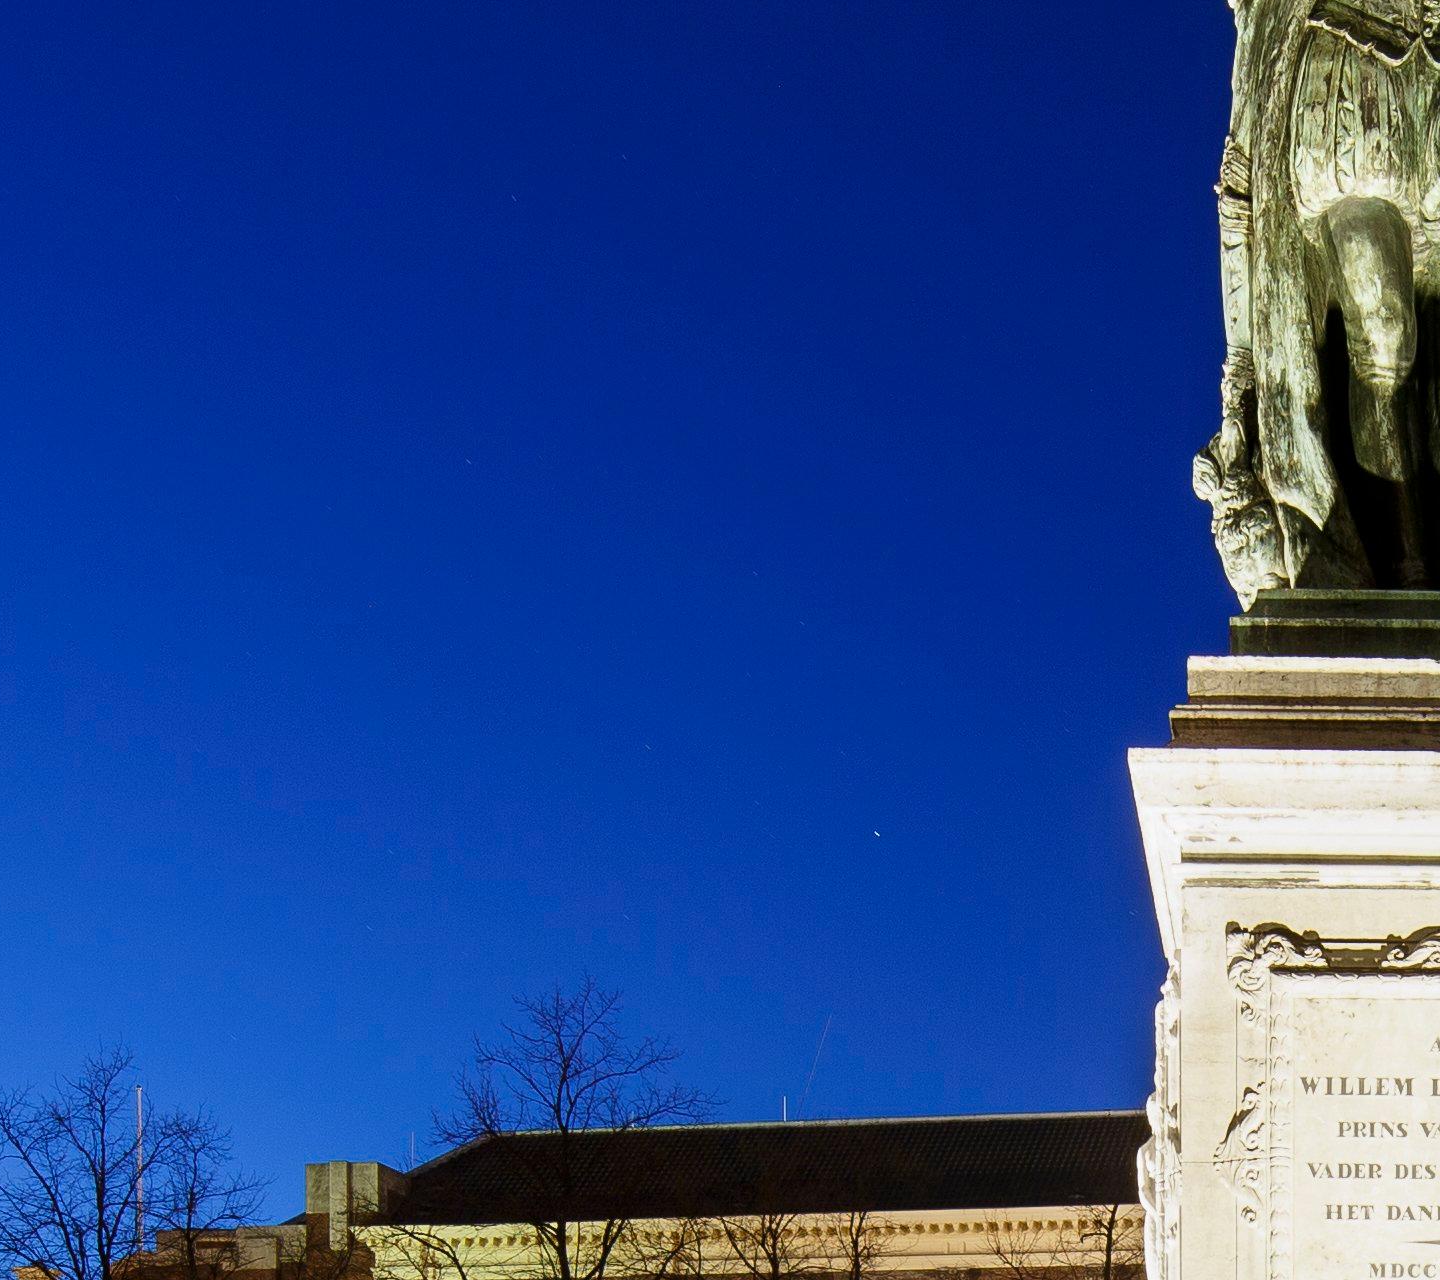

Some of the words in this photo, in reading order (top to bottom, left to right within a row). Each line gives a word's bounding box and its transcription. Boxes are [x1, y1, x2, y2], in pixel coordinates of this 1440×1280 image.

[1300, 1077, 1414, 1096] WILLEM
[1337, 1122, 1408, 1138] PRINS
[1308, 1163, 1382, 1179] VADER
[1395, 1164, 1436, 1179] DES
[1326, 1205, 1374, 1220] HET
